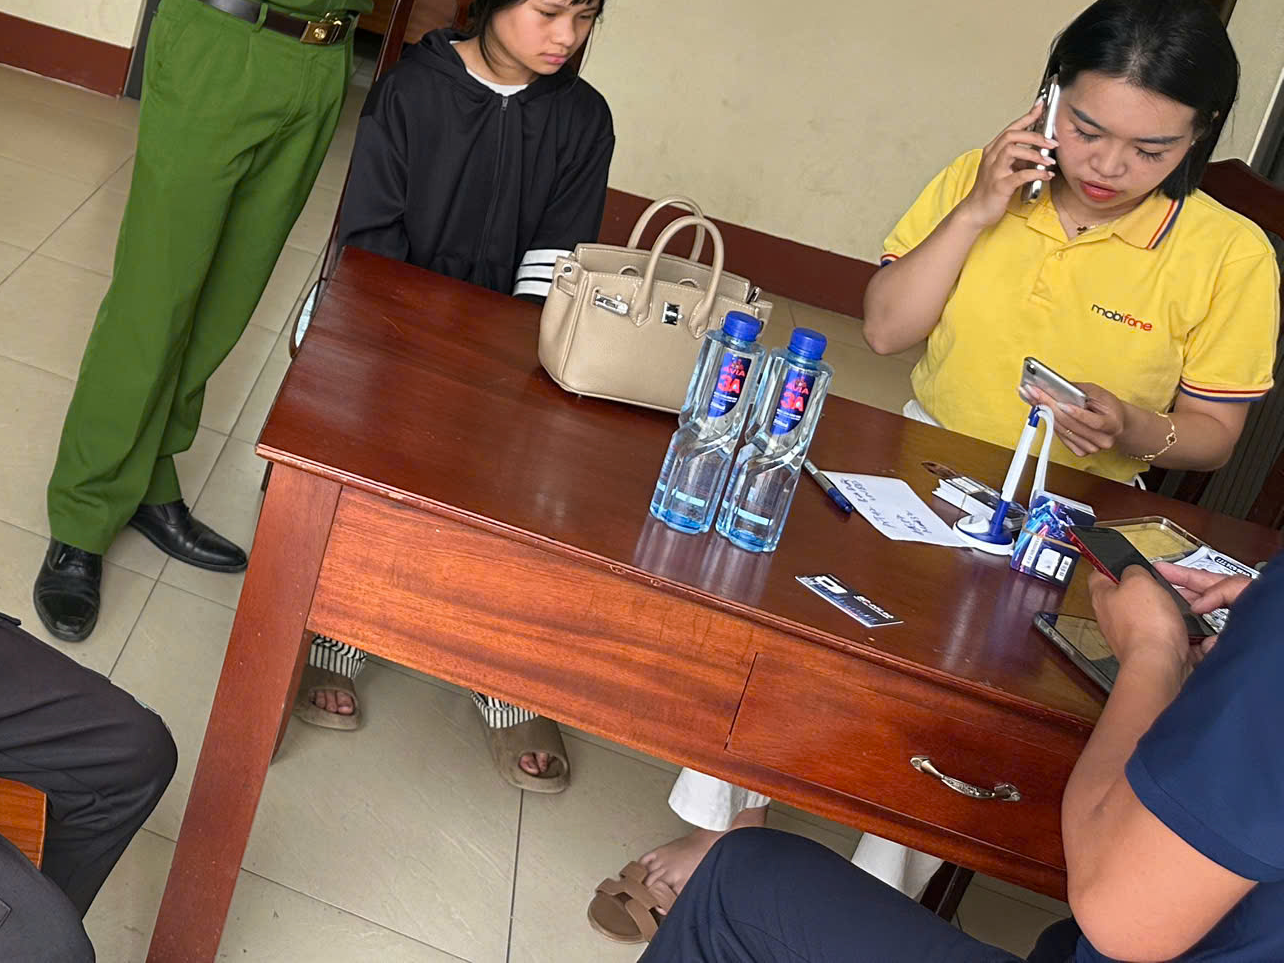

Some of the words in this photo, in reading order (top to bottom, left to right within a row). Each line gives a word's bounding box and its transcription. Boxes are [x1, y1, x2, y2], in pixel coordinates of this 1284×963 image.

[1091, 303, 1153, 332] mobifone
[717, 374, 741, 394] 3A
[780, 391, 804, 412] 3A
